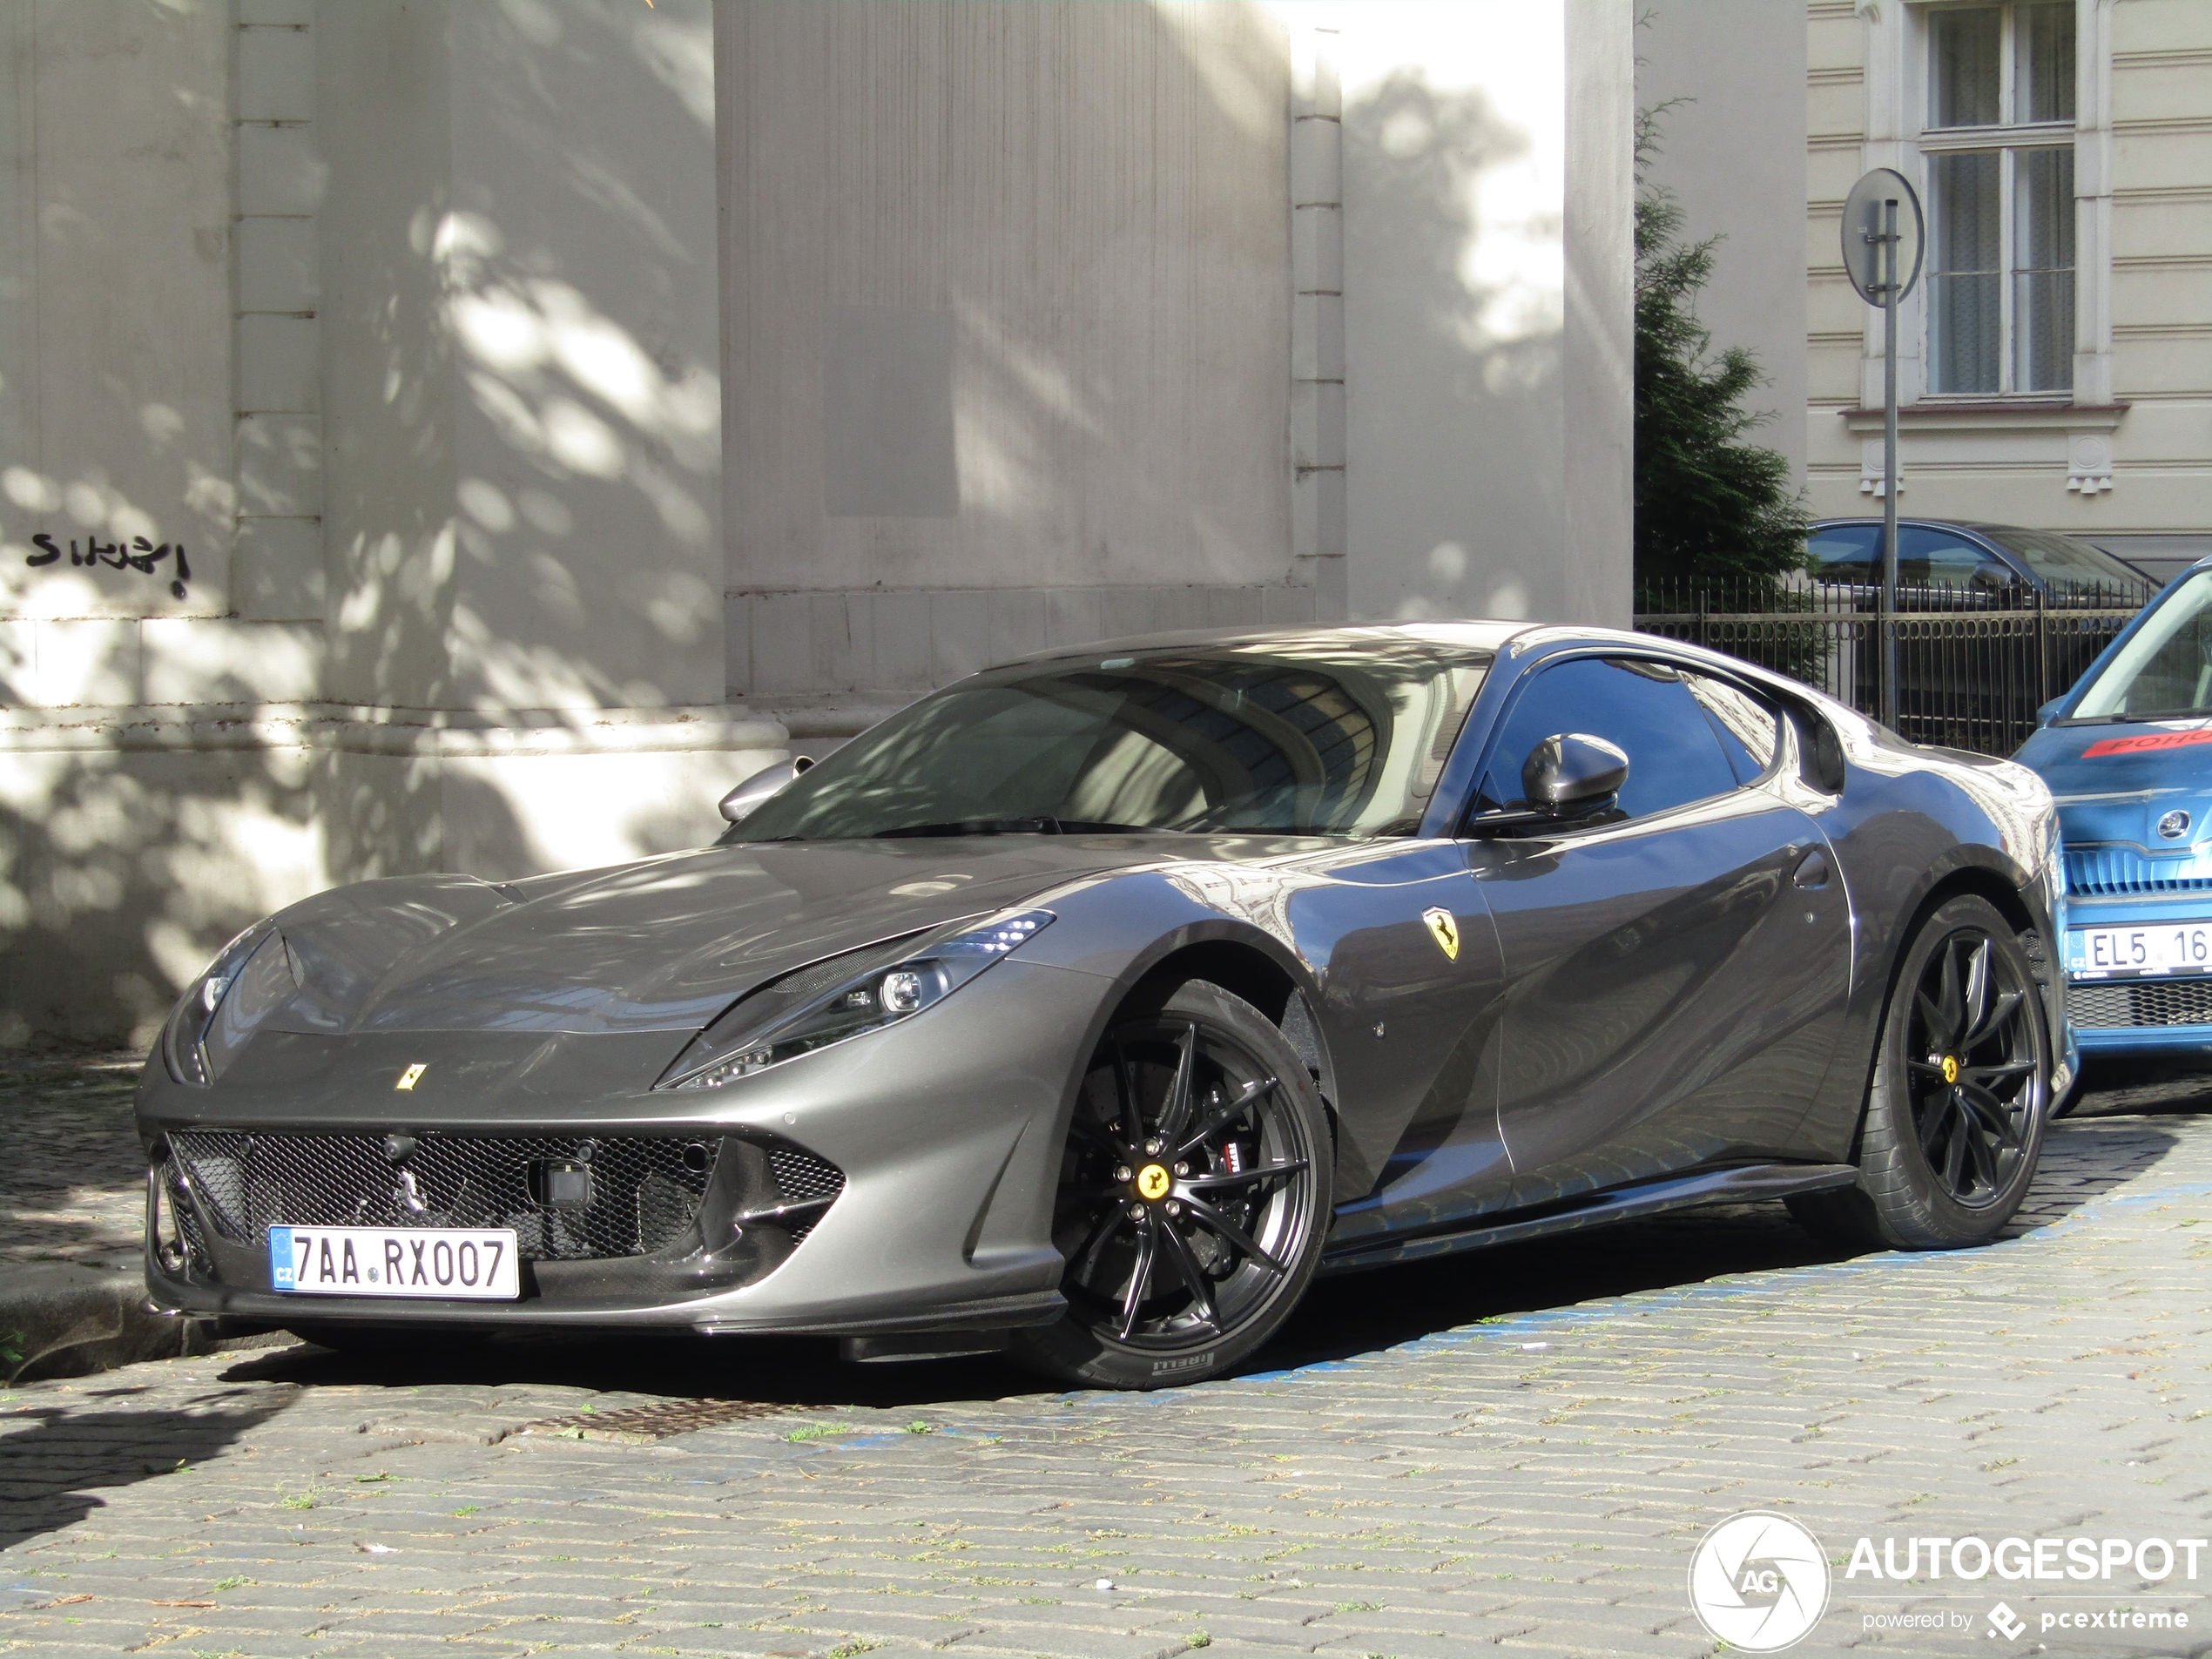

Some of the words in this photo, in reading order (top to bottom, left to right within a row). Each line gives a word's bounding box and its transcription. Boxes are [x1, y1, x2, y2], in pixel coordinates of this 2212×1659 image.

[2094, 933, 2147, 967] EL5
[2175, 930, 2208, 961] 16
[2070, 956, 2087, 968] CZ
[294, 1237, 360, 1284] 7AA
[384, 1238, 504, 1287] RX007
[275, 1267, 293, 1282] CZ
[1151, 1352, 1215, 1376] PIRELLI
